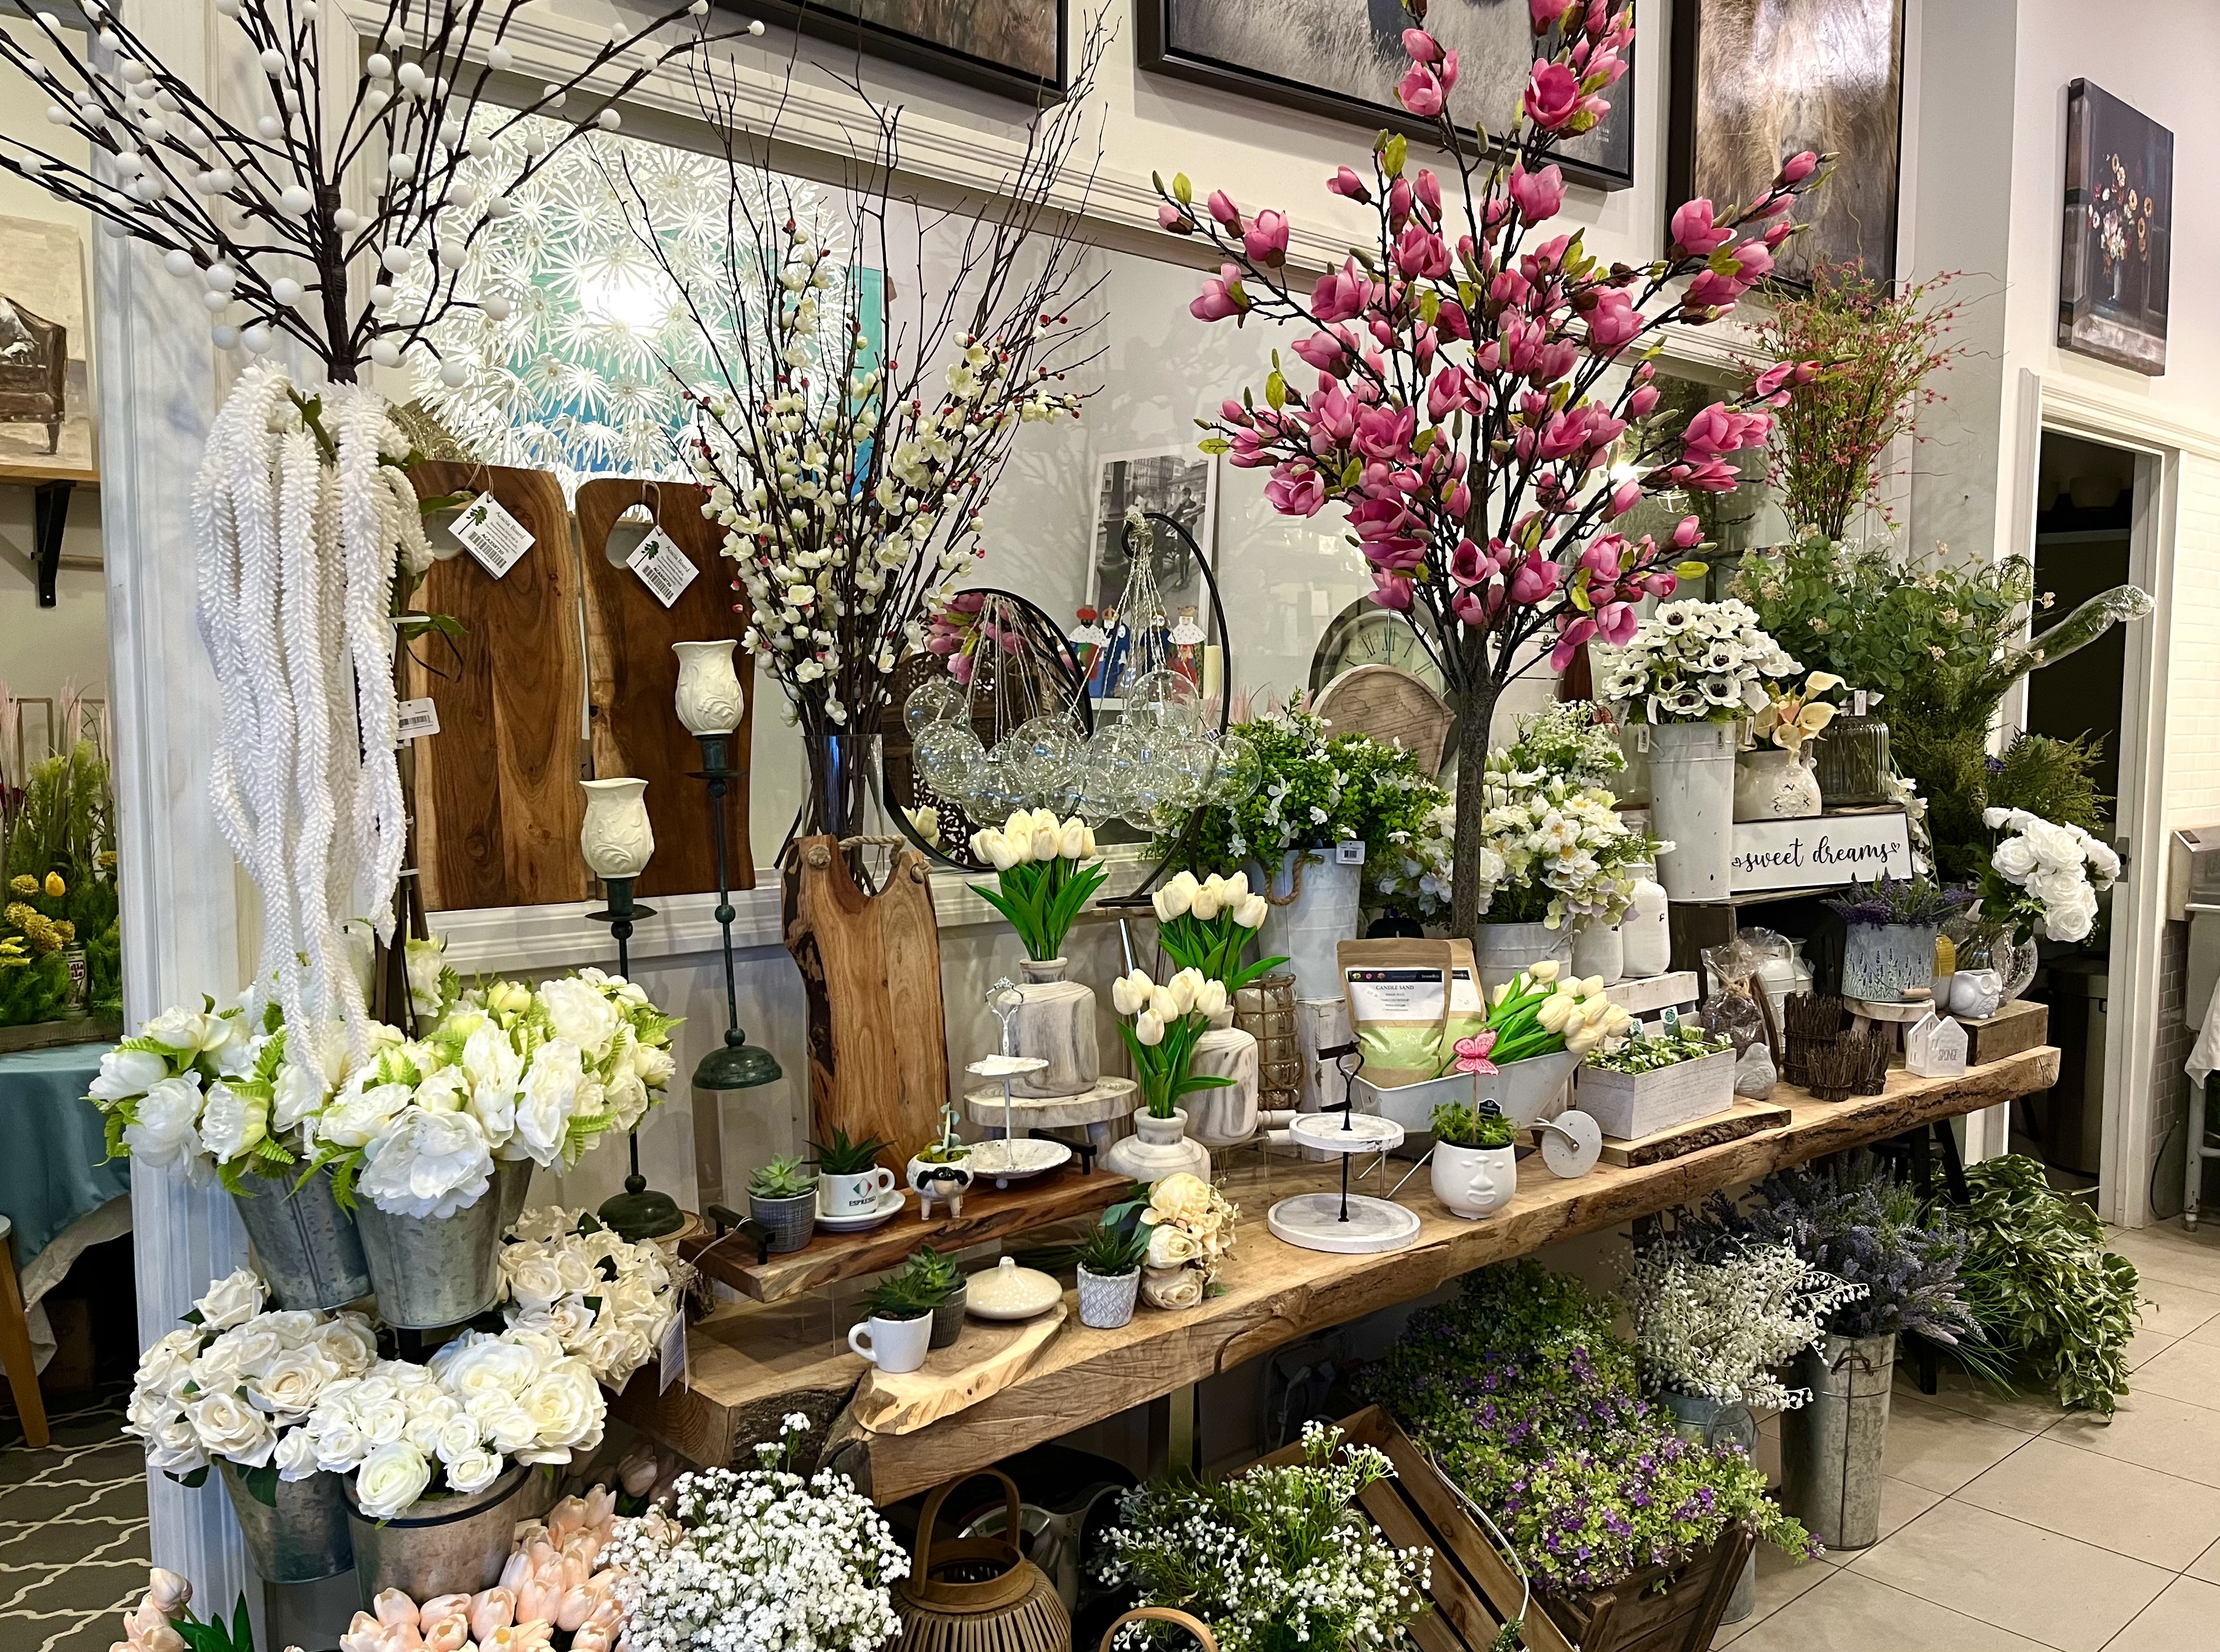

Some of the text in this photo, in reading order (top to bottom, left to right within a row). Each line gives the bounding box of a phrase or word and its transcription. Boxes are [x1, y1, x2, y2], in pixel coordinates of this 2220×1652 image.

[495, 510, 512, 526] Acacia
[509, 524, 526, 539] Board
[665, 544, 680, 560] Acacia
[677, 558, 691, 572] Board
[1741, 836, 1888, 872] sweet dreams
[1938, 1049, 1957, 1061] SPONGE
[849, 1196, 876, 1206] ESPRESSO
